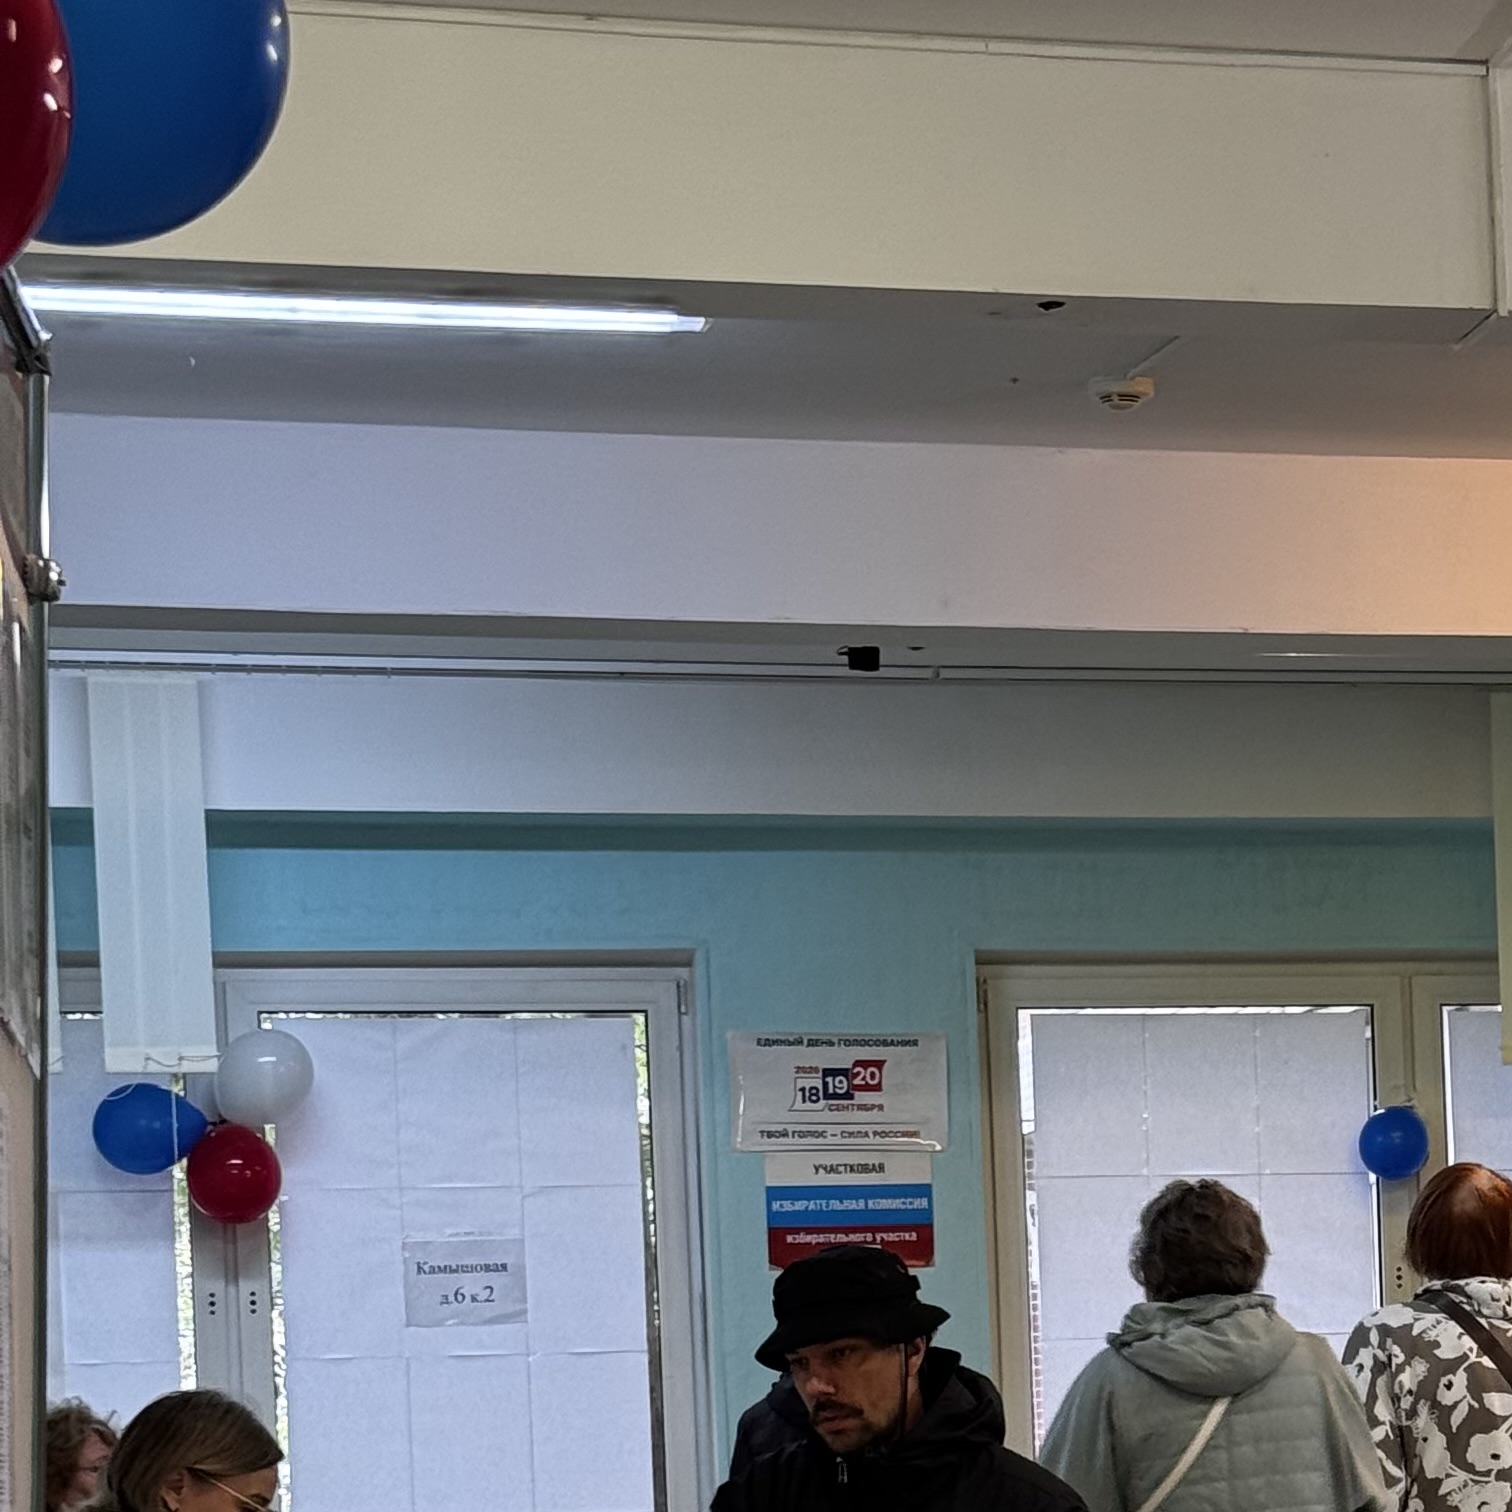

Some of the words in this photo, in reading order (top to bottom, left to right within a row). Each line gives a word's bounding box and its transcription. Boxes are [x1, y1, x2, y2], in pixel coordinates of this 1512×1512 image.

[756, 1036, 804, 1048] ЕДИНЫЙ
[806, 1038, 836, 1048] ДЕНЬ
[837, 1037, 919, 1048] ГОЛОСОВАНИЯ
[798, 1086, 821, 1104] 18
[825, 1076, 848, 1094] 19
[852, 1067, 880, 1085] 20
[827, 1103, 885, 1113] СЕНТЯБРЯ
[758, 1127, 790, 1139] ТВОЙ
[791, 1129, 828, 1139] ГОЛОС
[812, 1163, 885, 1176] УЧАСТКОВАЯ
[772, 1199, 866, 1212] ИЗБИРАТЕЛЬНАЯ
[868, 1197, 929, 1211] КОМИССИЯ
[786, 1232, 873, 1245] избирательного
[875, 1232, 918, 1244] участка
[415, 1260, 509, 1276] Камышовая
